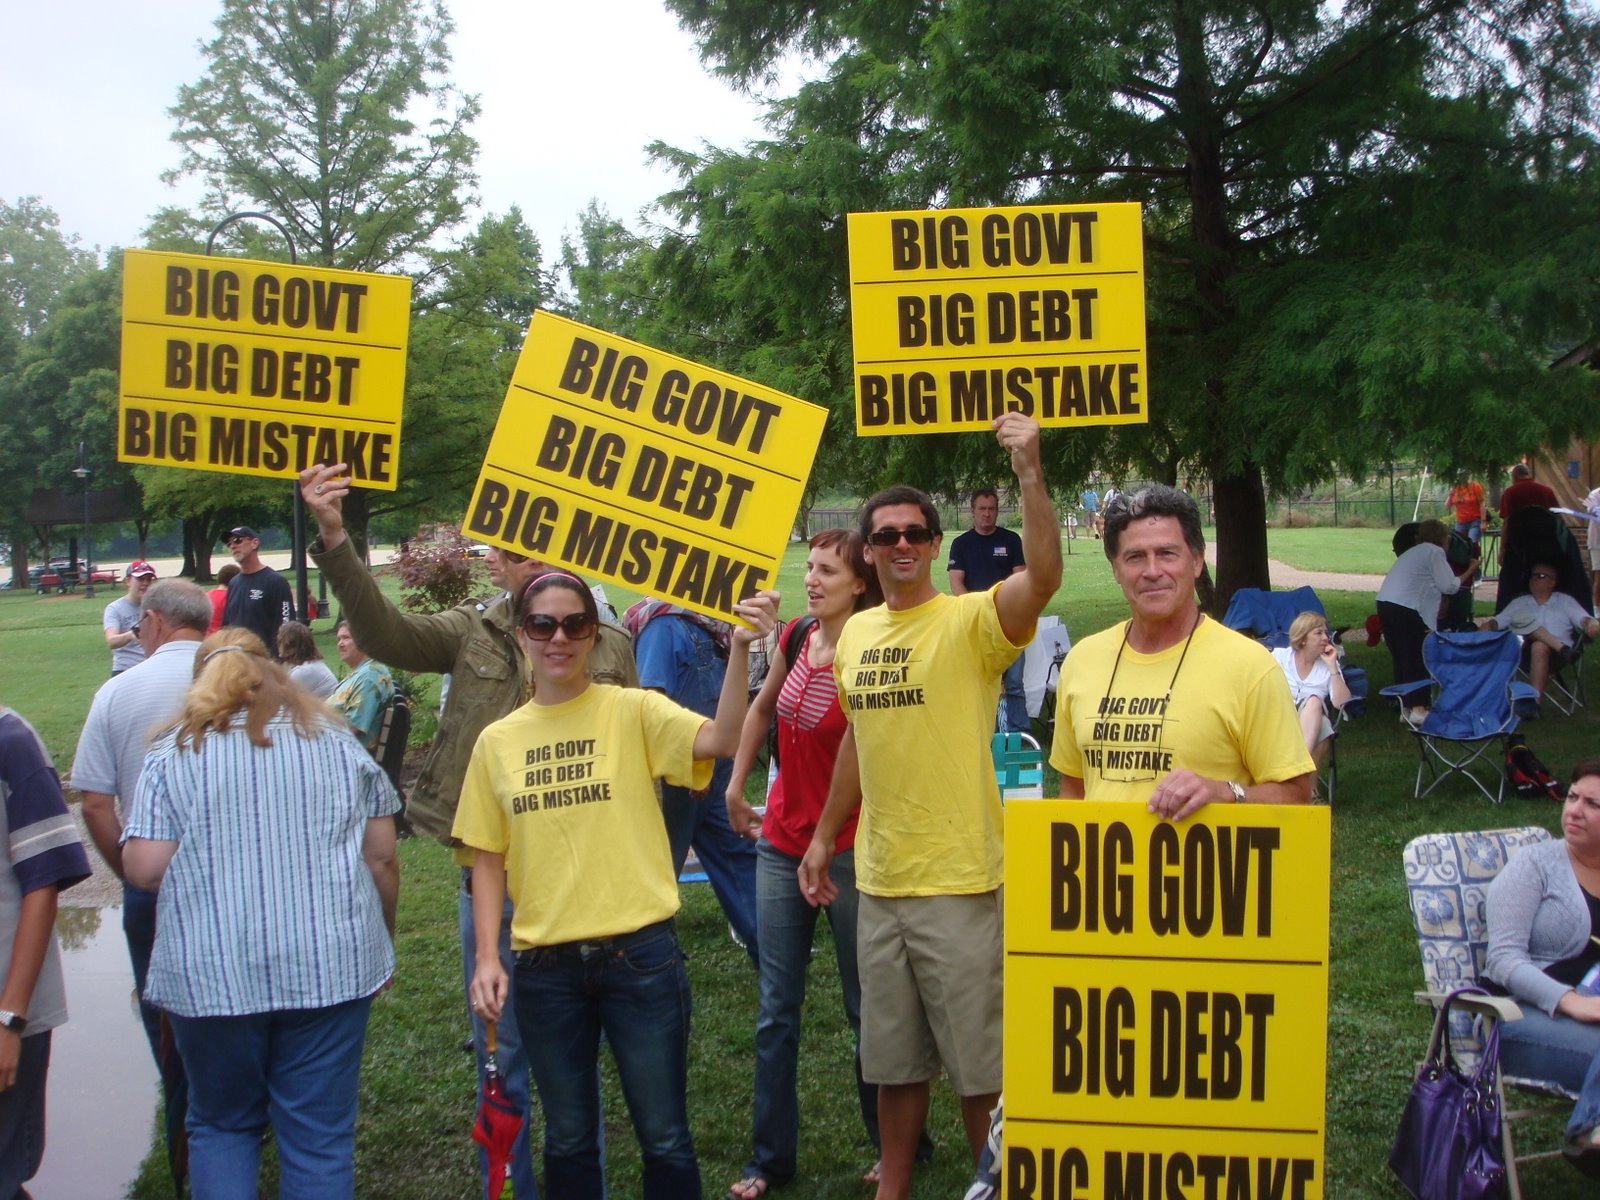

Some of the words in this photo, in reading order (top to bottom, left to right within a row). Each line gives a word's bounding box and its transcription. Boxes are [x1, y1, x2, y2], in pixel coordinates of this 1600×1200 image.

[891, 215, 969, 271] BIG
[981, 212, 1097, 268] GOVT
[164, 266, 240, 322] BIG
[252, 274, 368, 333] GOVT
[897, 292, 975, 348] BIG
[988, 288, 1097, 344] DEBT
[164, 339, 239, 394] BIG
[251, 348, 360, 406] DEBT
[559, 337, 648, 413] BIG
[651, 370, 782, 455] GOVT
[860, 372, 938, 426] BIG
[950, 363, 1140, 422] MISTAKE
[124, 408, 197, 462] BIG
[208, 416, 392, 483] MISTAKE
[535, 414, 626, 491] BIG
[627, 444, 754, 530] DEBT
[468, 478, 559, 555] BIG
[560, 508, 770, 616] MISTAKE
[855, 671, 876, 687] BIG
[860, 649, 880, 664] BIG
[882, 648, 912, 663] GOV
[848, 694, 863, 710] BIG
[866, 689, 924, 709] MISTAKE
[1098, 697, 1126, 714] BIG
[1128, 698, 1170, 715] GOVT
[526, 745, 550, 765] BIG
[555, 739, 595, 759] GOVT
[1093, 723, 1120, 741] BIG
[1124, 724, 1162, 742] DEBT
[1107, 751, 1172, 771] MISTAKE
[513, 794, 539, 815] BIG
[543, 783, 611, 810] MISTAKE
[525, 768, 552, 787] BIG
[557, 762, 593, 782] DEBT
[1051, 821, 1134, 936] BIG
[1148, 823, 1280, 938] GOVT
[1052, 986, 1135, 1099] BIG
[1150, 989, 1274, 1102] DEBT
[1007, 1146, 1089, 1200] BIG
